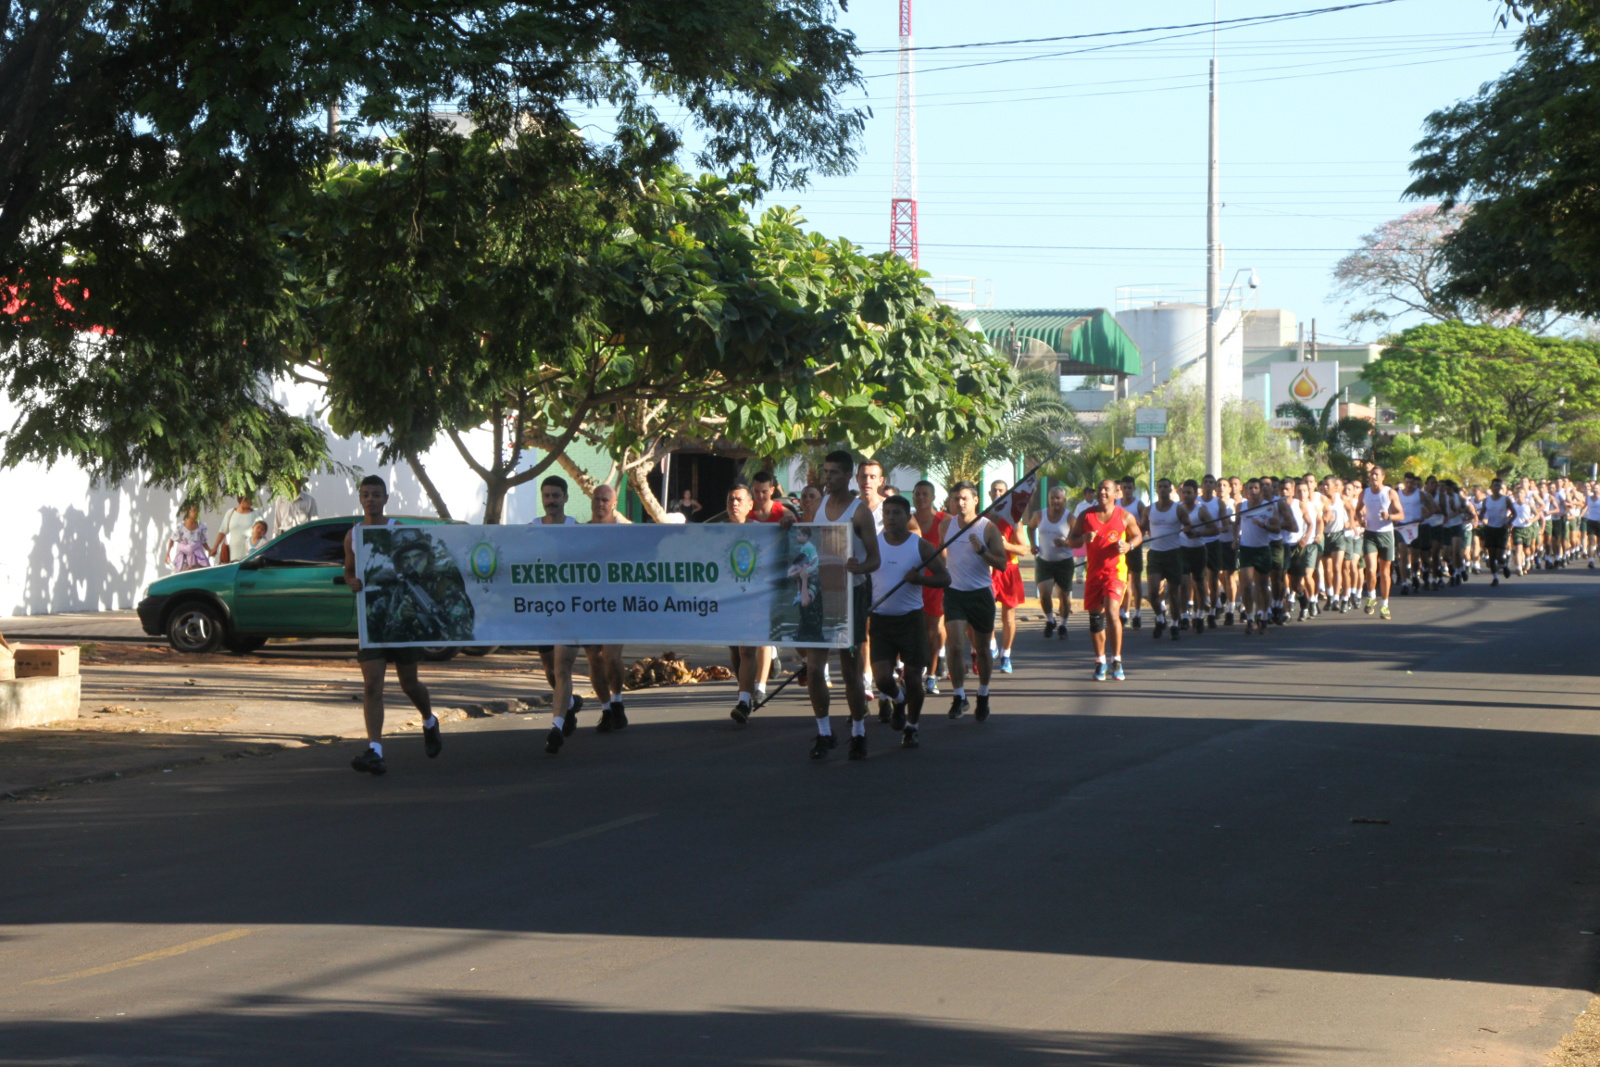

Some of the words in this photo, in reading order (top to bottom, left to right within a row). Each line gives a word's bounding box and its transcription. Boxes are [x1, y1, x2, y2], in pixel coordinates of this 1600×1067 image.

[511, 558, 602, 584] EXÉRCITO
[606, 561, 720, 584] BRASILEIRO
[514, 596, 566, 616] Braço
[571, 596, 617, 613] Forte
[622, 595, 659, 613] Mão
[663, 596, 719, 617] Amiga
